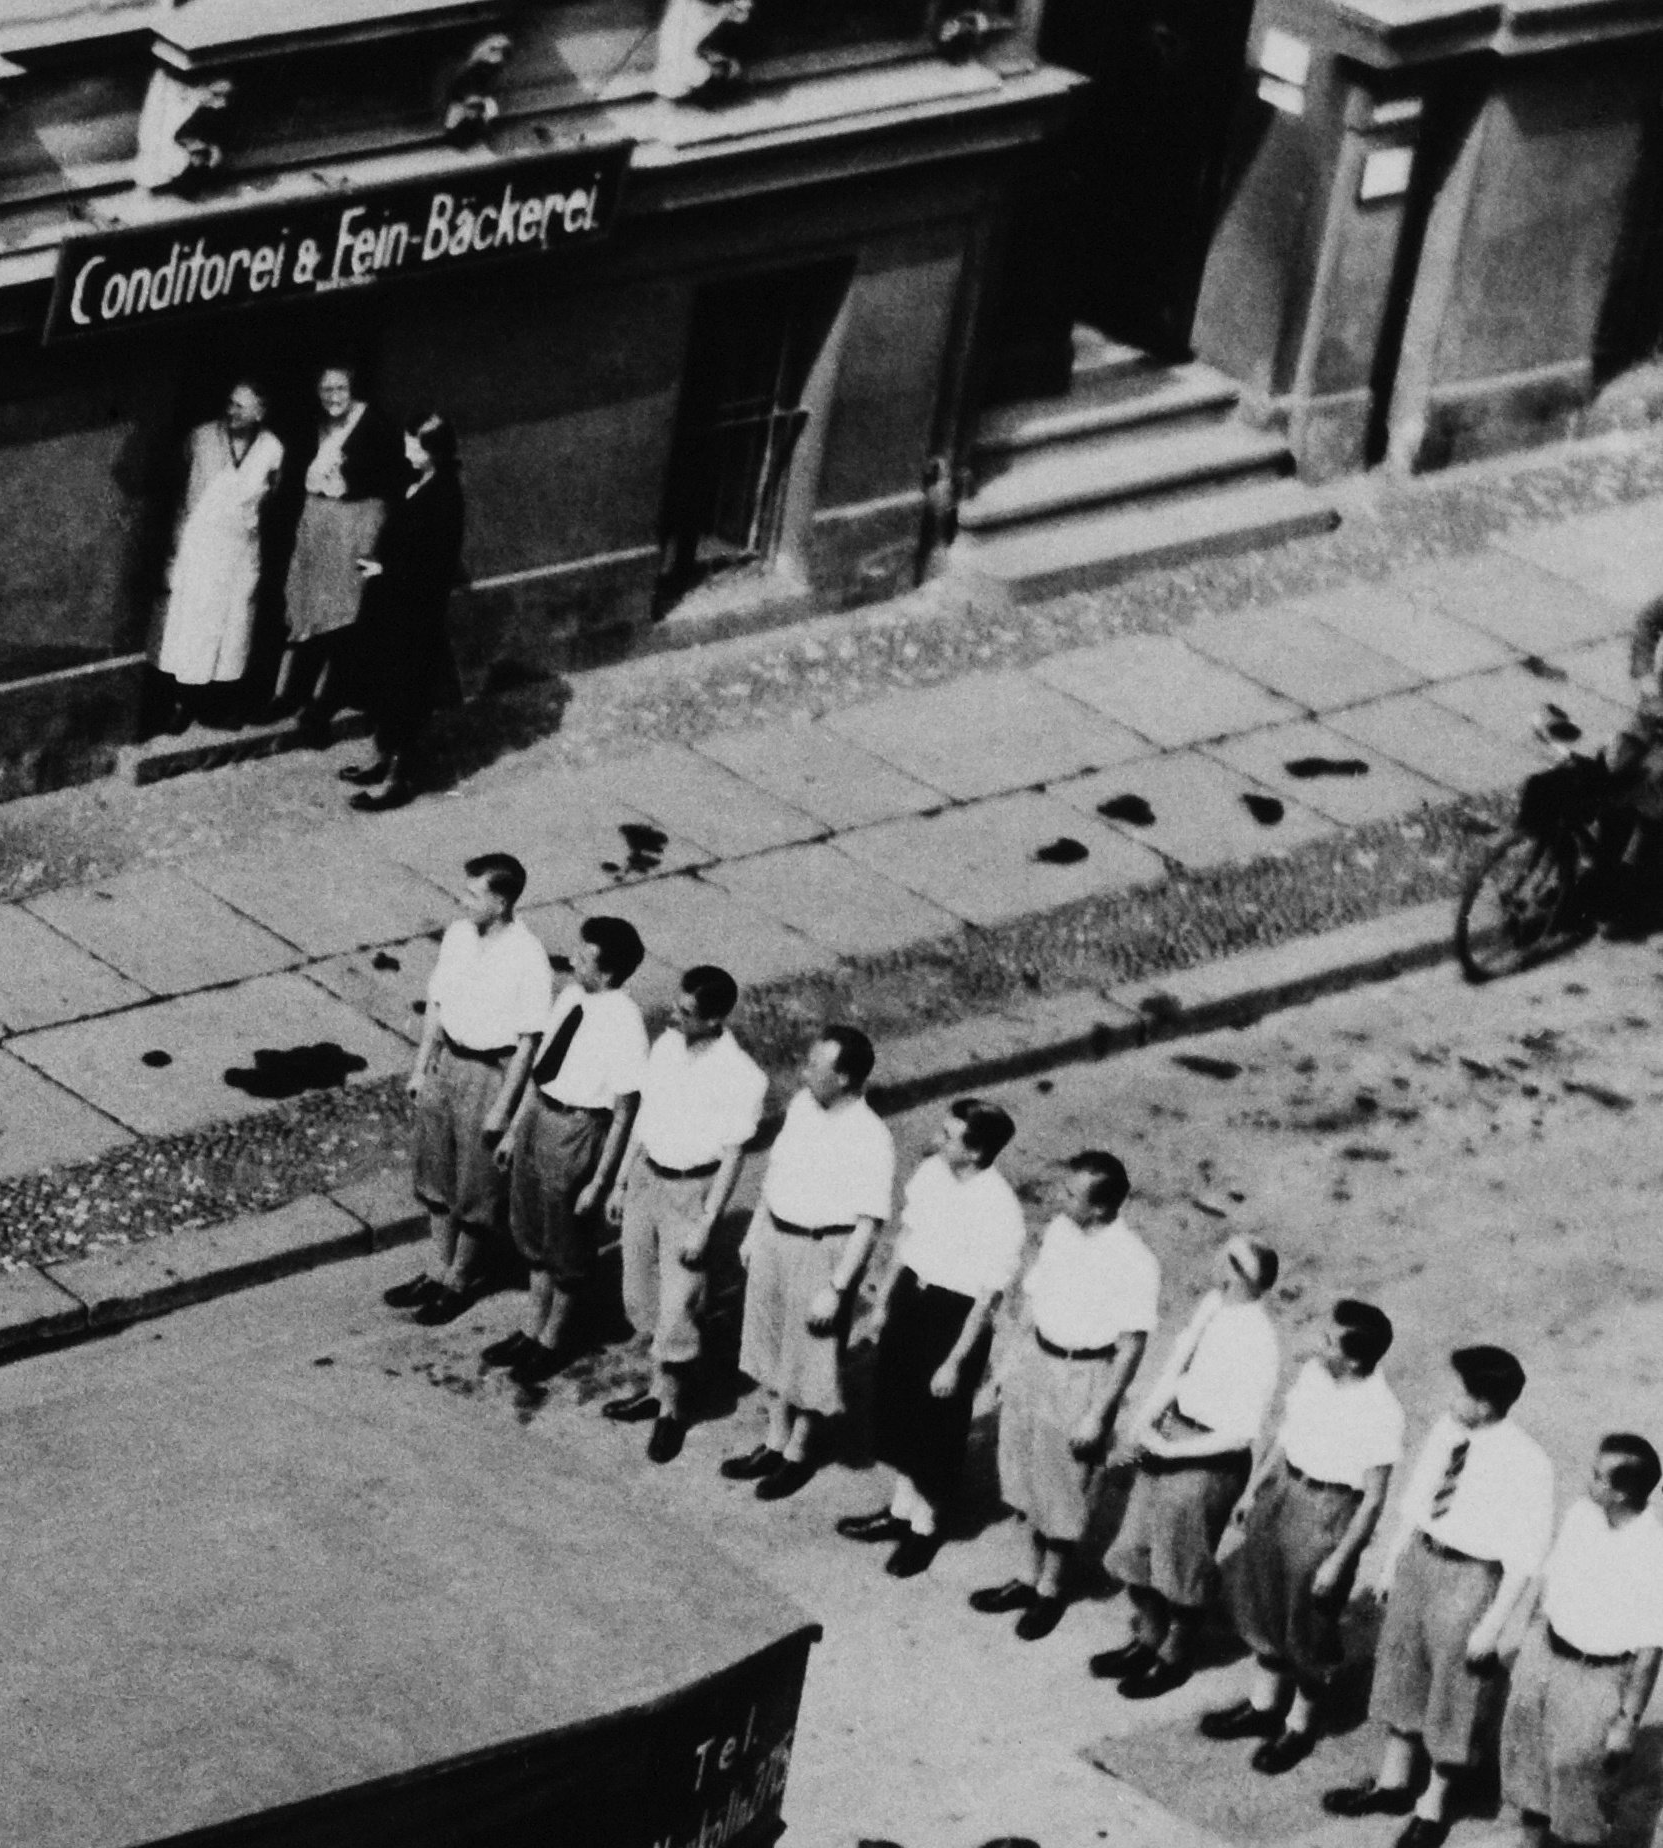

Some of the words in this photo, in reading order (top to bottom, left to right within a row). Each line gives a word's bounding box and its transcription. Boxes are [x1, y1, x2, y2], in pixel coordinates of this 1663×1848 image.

[70, 228, 289, 325] Conditorei
[292, 236, 321, 284] &
[693, 1703, 758, 1792] Tel.
